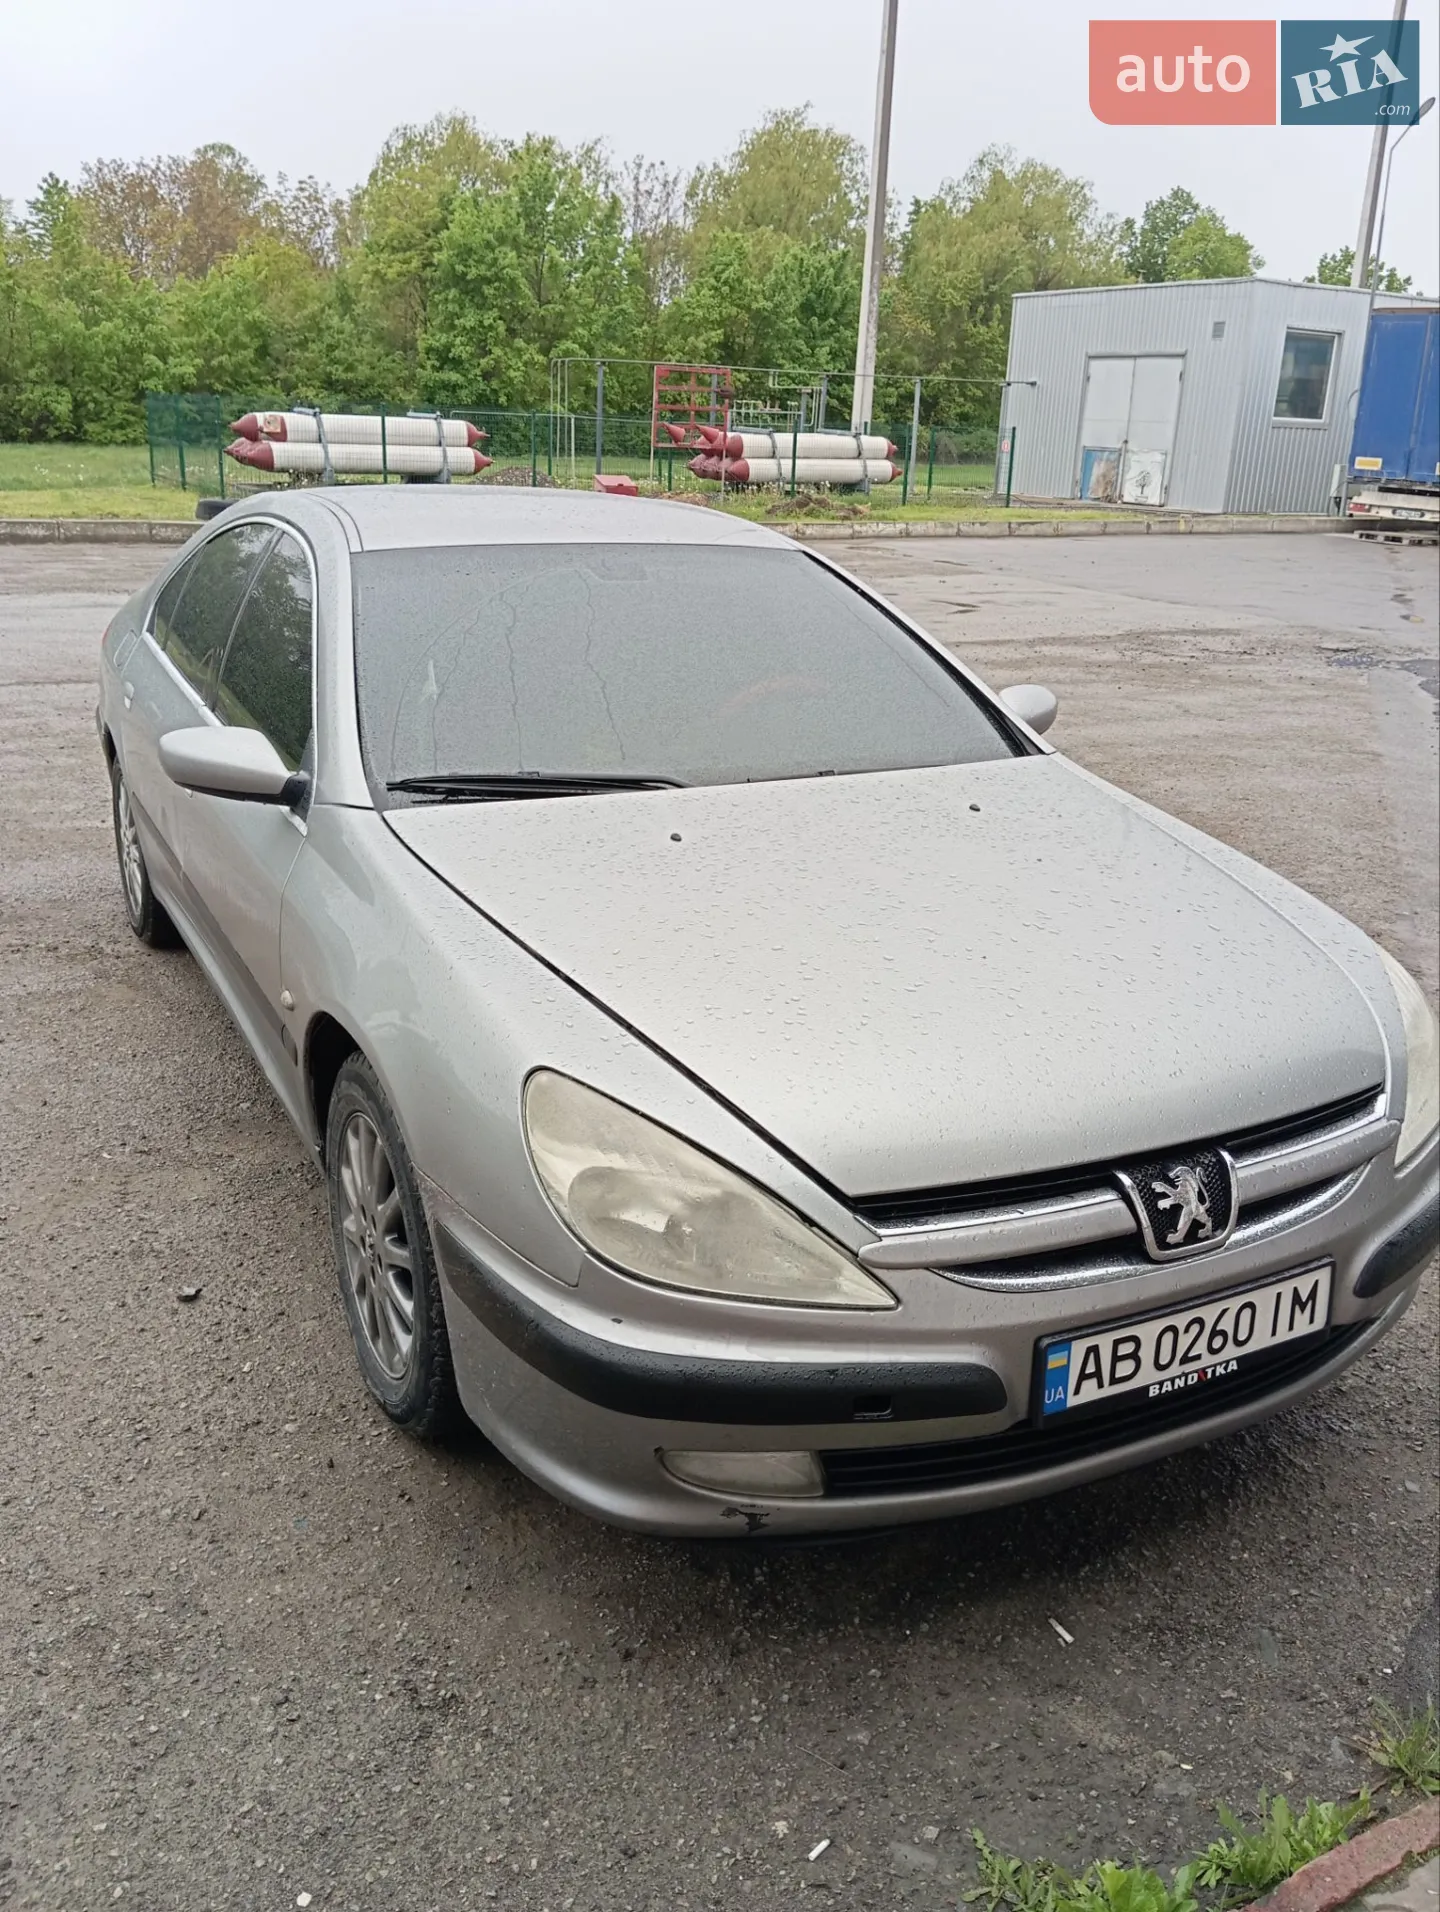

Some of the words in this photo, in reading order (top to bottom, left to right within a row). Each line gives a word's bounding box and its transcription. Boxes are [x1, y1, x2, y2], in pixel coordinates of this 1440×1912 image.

[1073, 1334, 1142, 1396] AB
[1153, 1301, 1257, 1371] 0260
[1270, 1279, 1319, 1338] IM
[1044, 1386, 1065, 1404] UA
